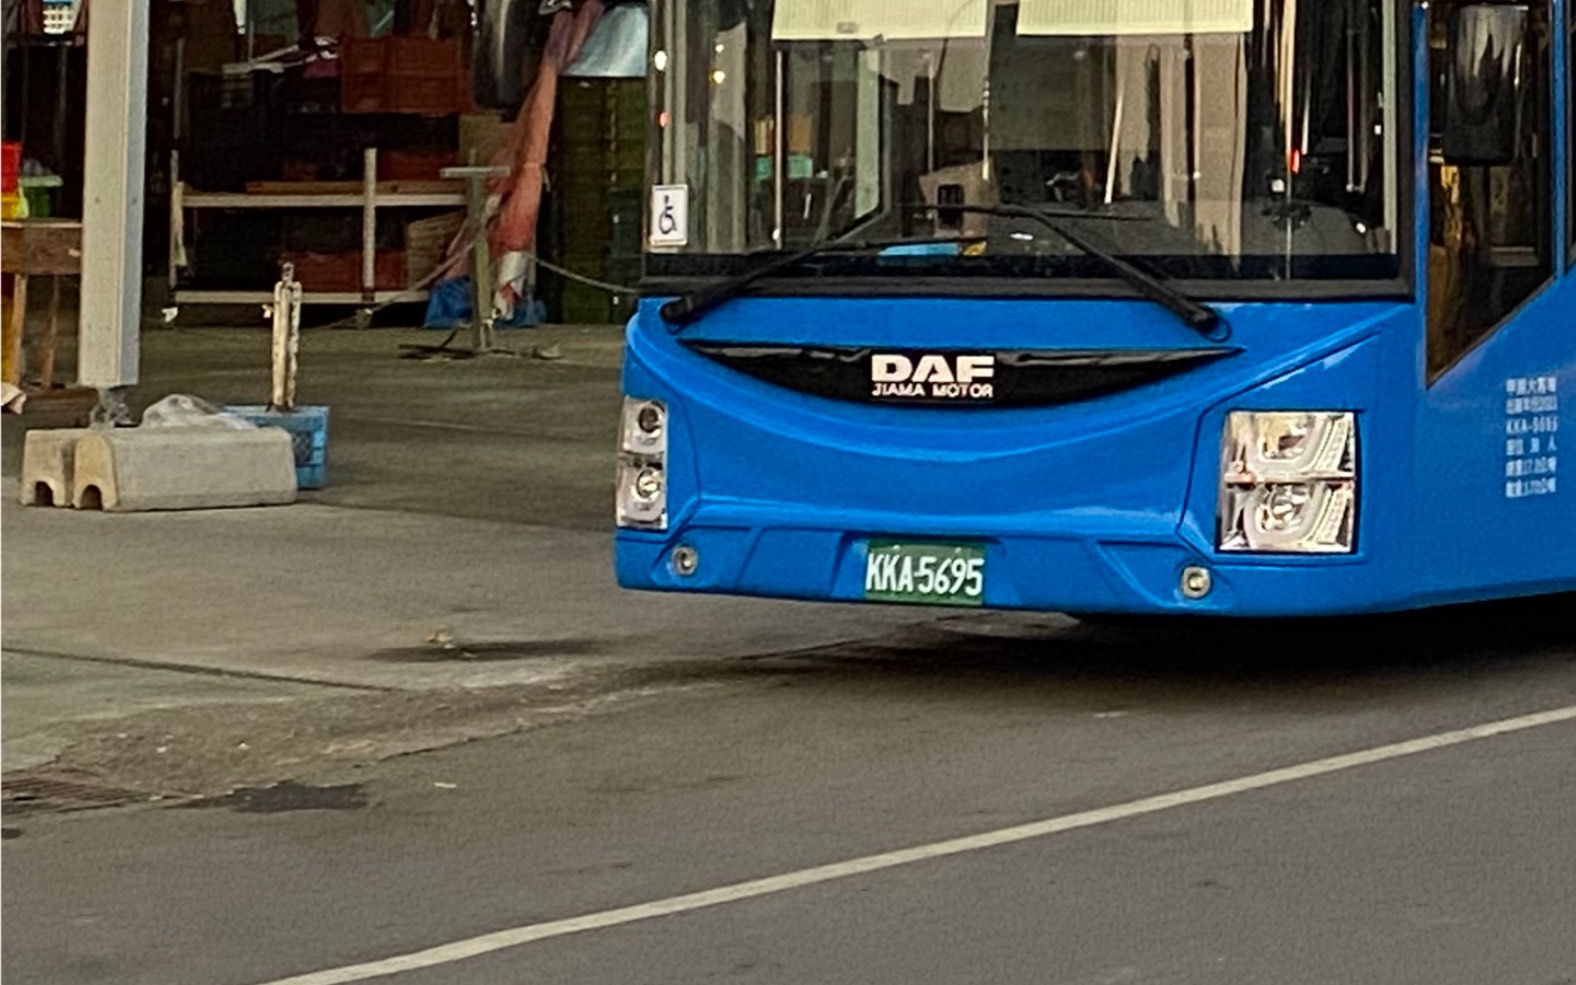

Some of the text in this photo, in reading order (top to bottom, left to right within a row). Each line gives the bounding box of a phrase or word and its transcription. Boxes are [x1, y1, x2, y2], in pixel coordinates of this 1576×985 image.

[871, 354, 995, 383] DAF
[872, 383, 994, 398] JIAMA MOTOR
[865, 549, 986, 596] KKA-5695
